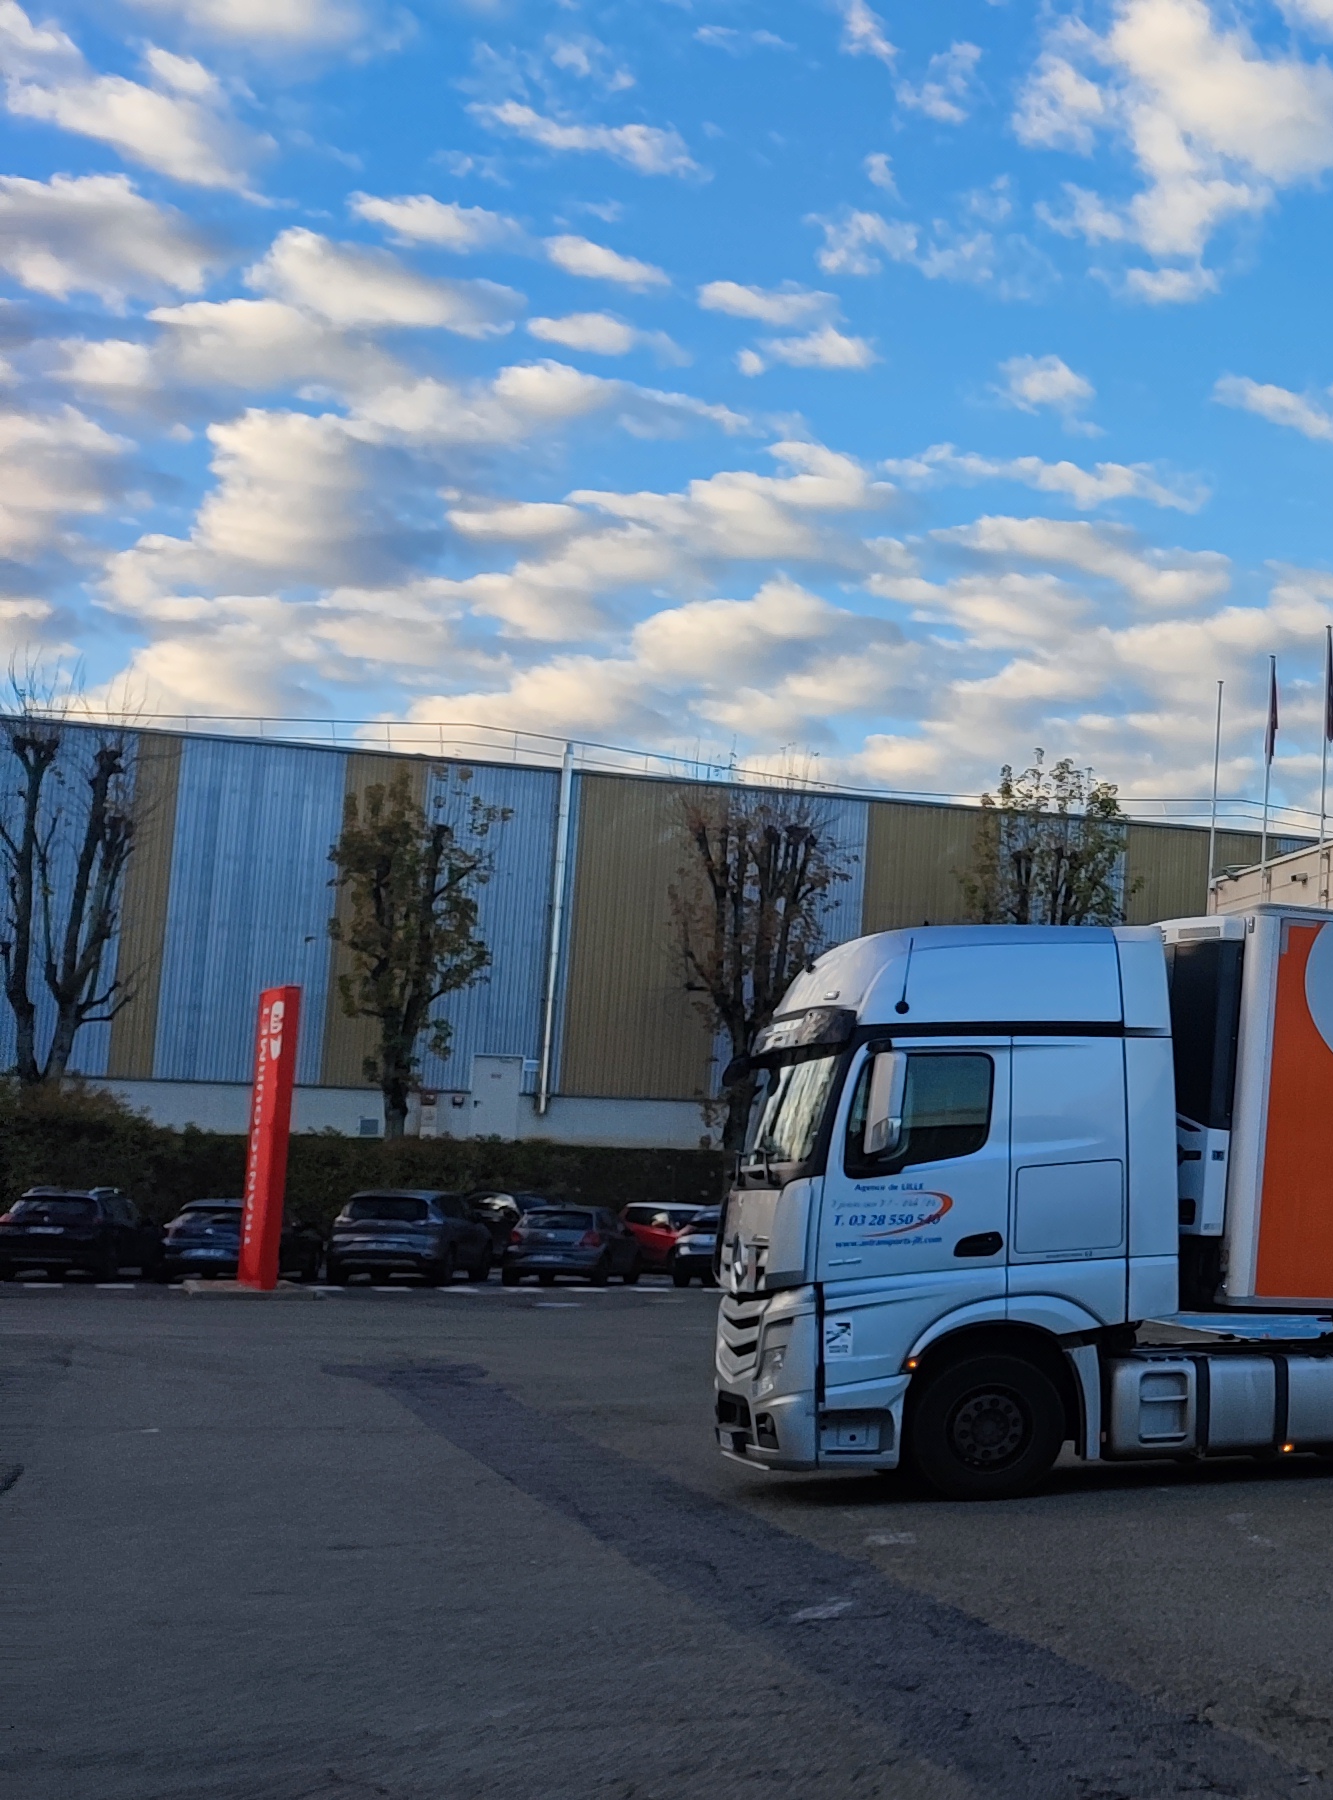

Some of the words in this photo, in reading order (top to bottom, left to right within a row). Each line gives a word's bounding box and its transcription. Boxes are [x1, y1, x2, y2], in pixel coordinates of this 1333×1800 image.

[848, 1214, 867, 1226] 03
[868, 1214, 887, 1226] 28
[888, 1213, 914, 1226] 550
